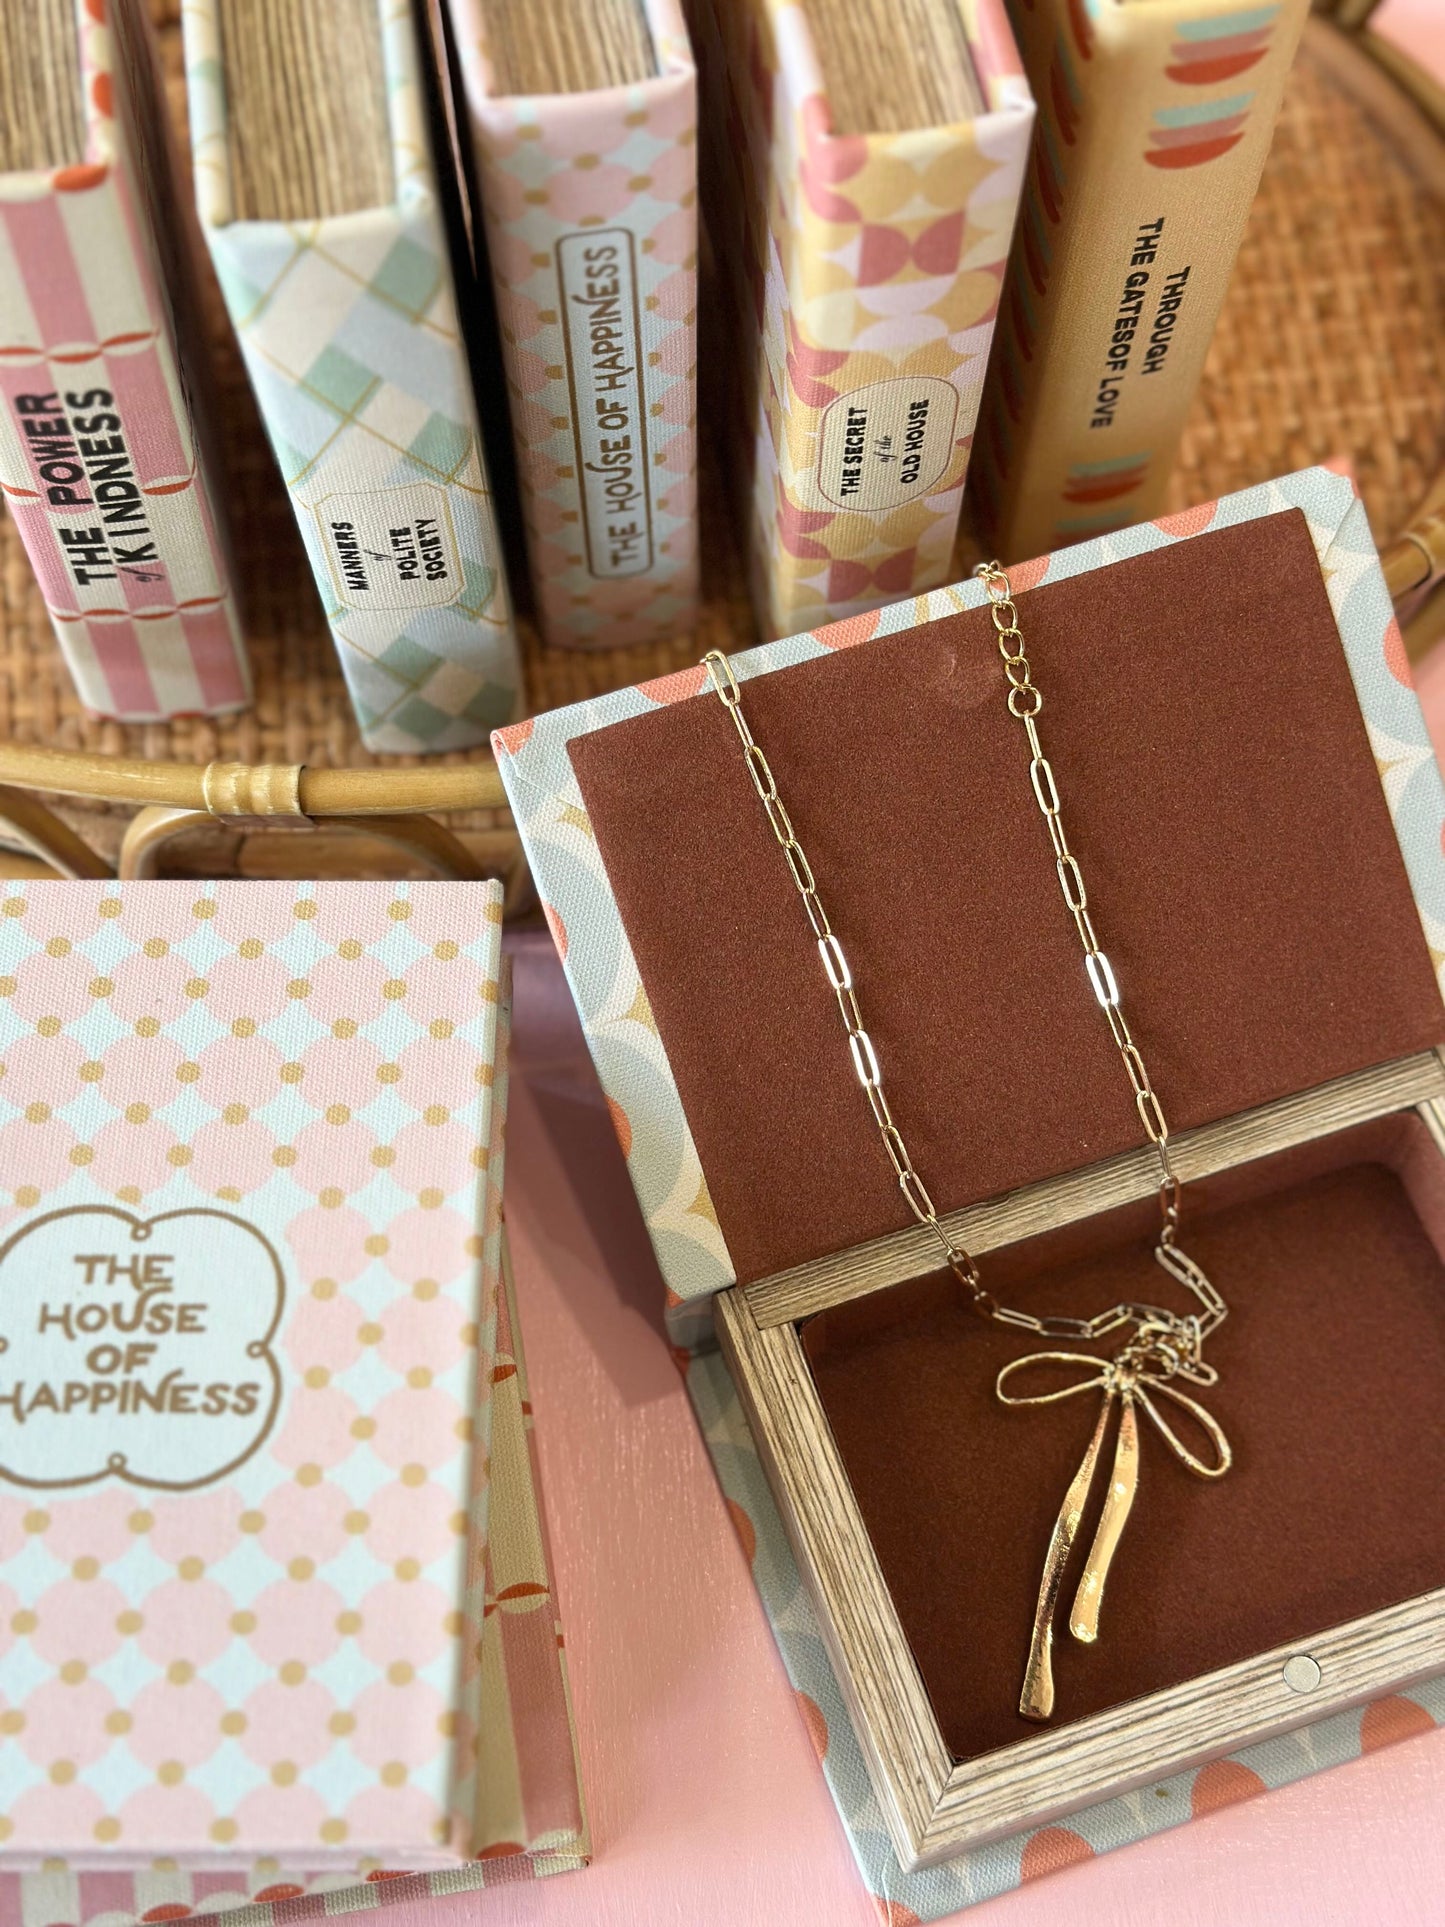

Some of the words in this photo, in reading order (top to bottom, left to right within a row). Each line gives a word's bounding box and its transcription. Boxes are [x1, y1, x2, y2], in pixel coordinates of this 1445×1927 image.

[1130, 217, 1165, 267] THE
[571, 246, 635, 391] HAPPINESS
[1141, 266, 1191, 375] THROUGH
[595, 398, 628, 430] OF
[904, 399, 929, 452] HOUSE
[1090, 376, 1124, 429] LOVE
[15, 392, 95, 506] POWER
[844, 407, 868, 464] SECRET
[65, 388, 159, 564] KINDNESS
[585, 434, 642, 514] HOUSE
[841, 468, 861, 496] THE
[900, 454, 921, 484] OLD
[59, 527, 117, 585] THE
[331, 521, 369, 591] MANNERS
[389, 527, 421, 580] POLITE
[414, 519, 448, 581] SOCIETY
[610, 522, 645, 566] THE
[74, 1254, 174, 1291] THE
[38, 1285, 208, 1341] HOUSE
[86, 1343, 158, 1375] OF
